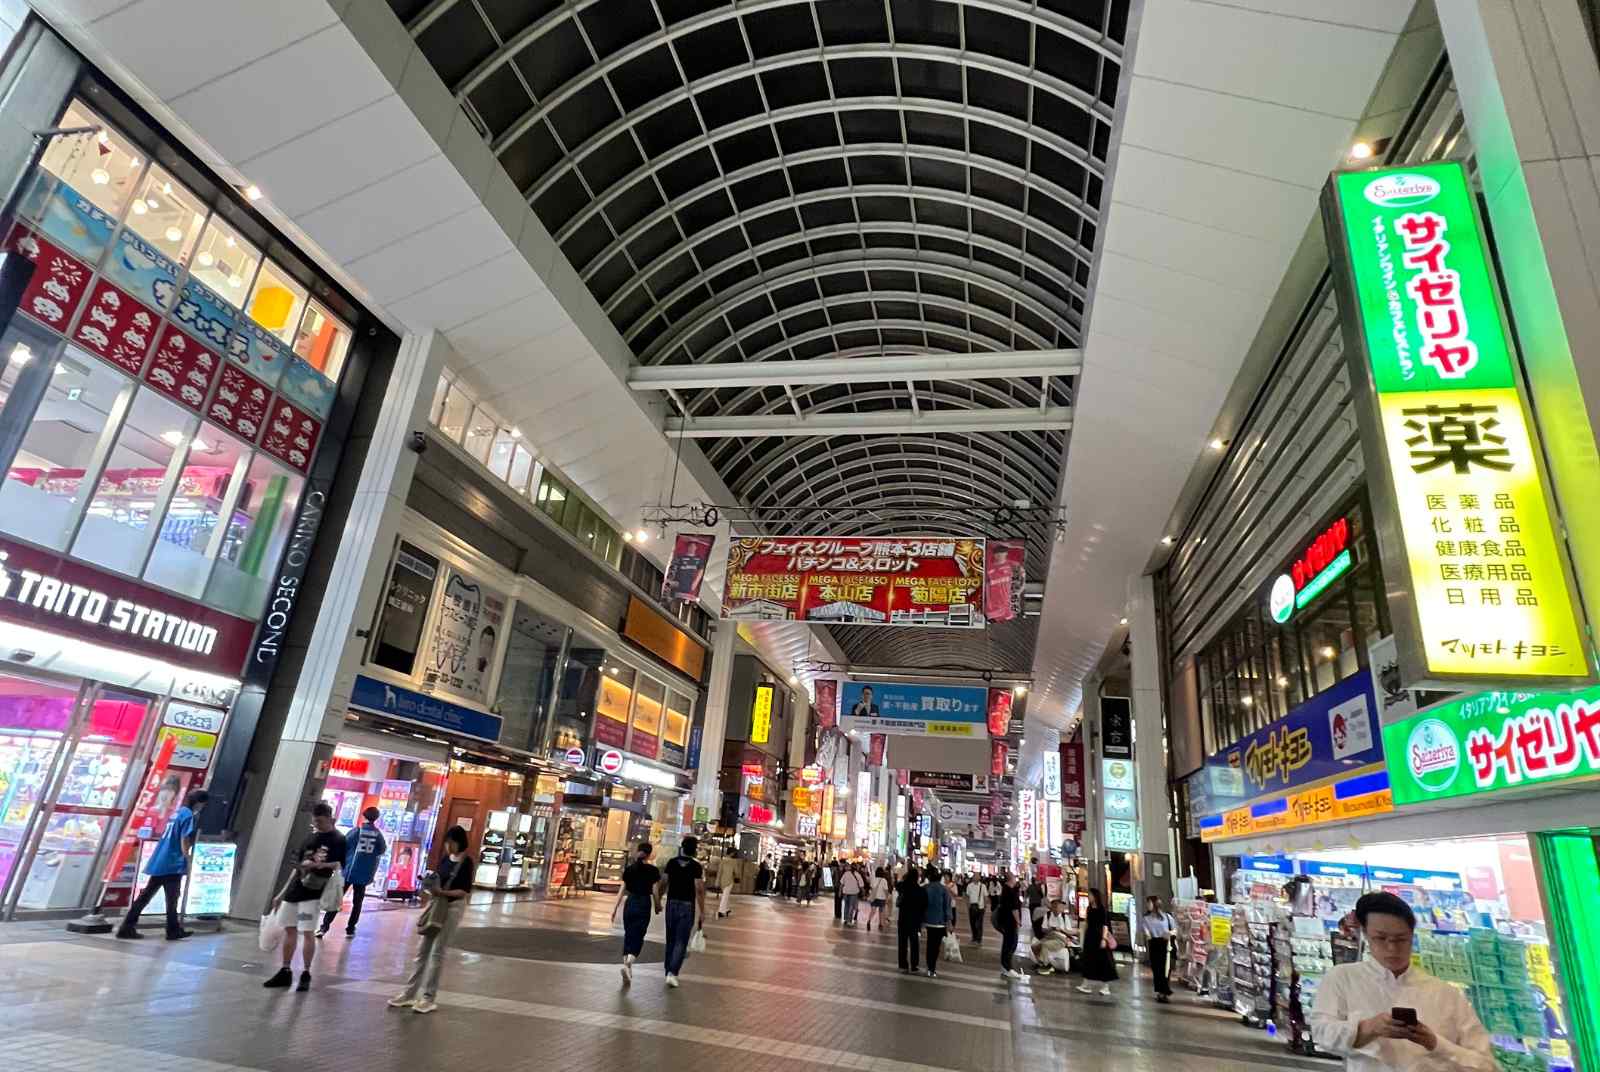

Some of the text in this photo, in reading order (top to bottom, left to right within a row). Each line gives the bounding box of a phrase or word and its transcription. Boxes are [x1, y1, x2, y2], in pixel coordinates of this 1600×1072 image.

[1401, 215, 1471, 373] サイゼリヤ
[1402, 403, 1516, 475] 薬
[1426, 493, 1516, 511] 医薬品
[288, 491, 325, 568] CARINO
[1431, 516, 1521, 534] 化粧品
[758, 538, 955, 560] フェイスグループ熊本3店舗
[1435, 539, 1527, 558] 健康食品
[786, 556, 920, 573] パチンコ&スロット
[1439, 563, 1533, 582] 医療用品
[808, 574, 839, 586] MEGA
[895, 576, 926, 588] MEGA
[729, 582, 799, 600] 新市街店
[819, 584, 873, 603] 本山店
[911, 585, 967, 605] 菊陽店
[1446, 588, 1539, 607] 日用品
[17, 570, 219, 656] TAITO STATION
[1440, 638, 1568, 660] マツモトキヨシ
[1469, 706, 1600, 781] サイゼリヤ
